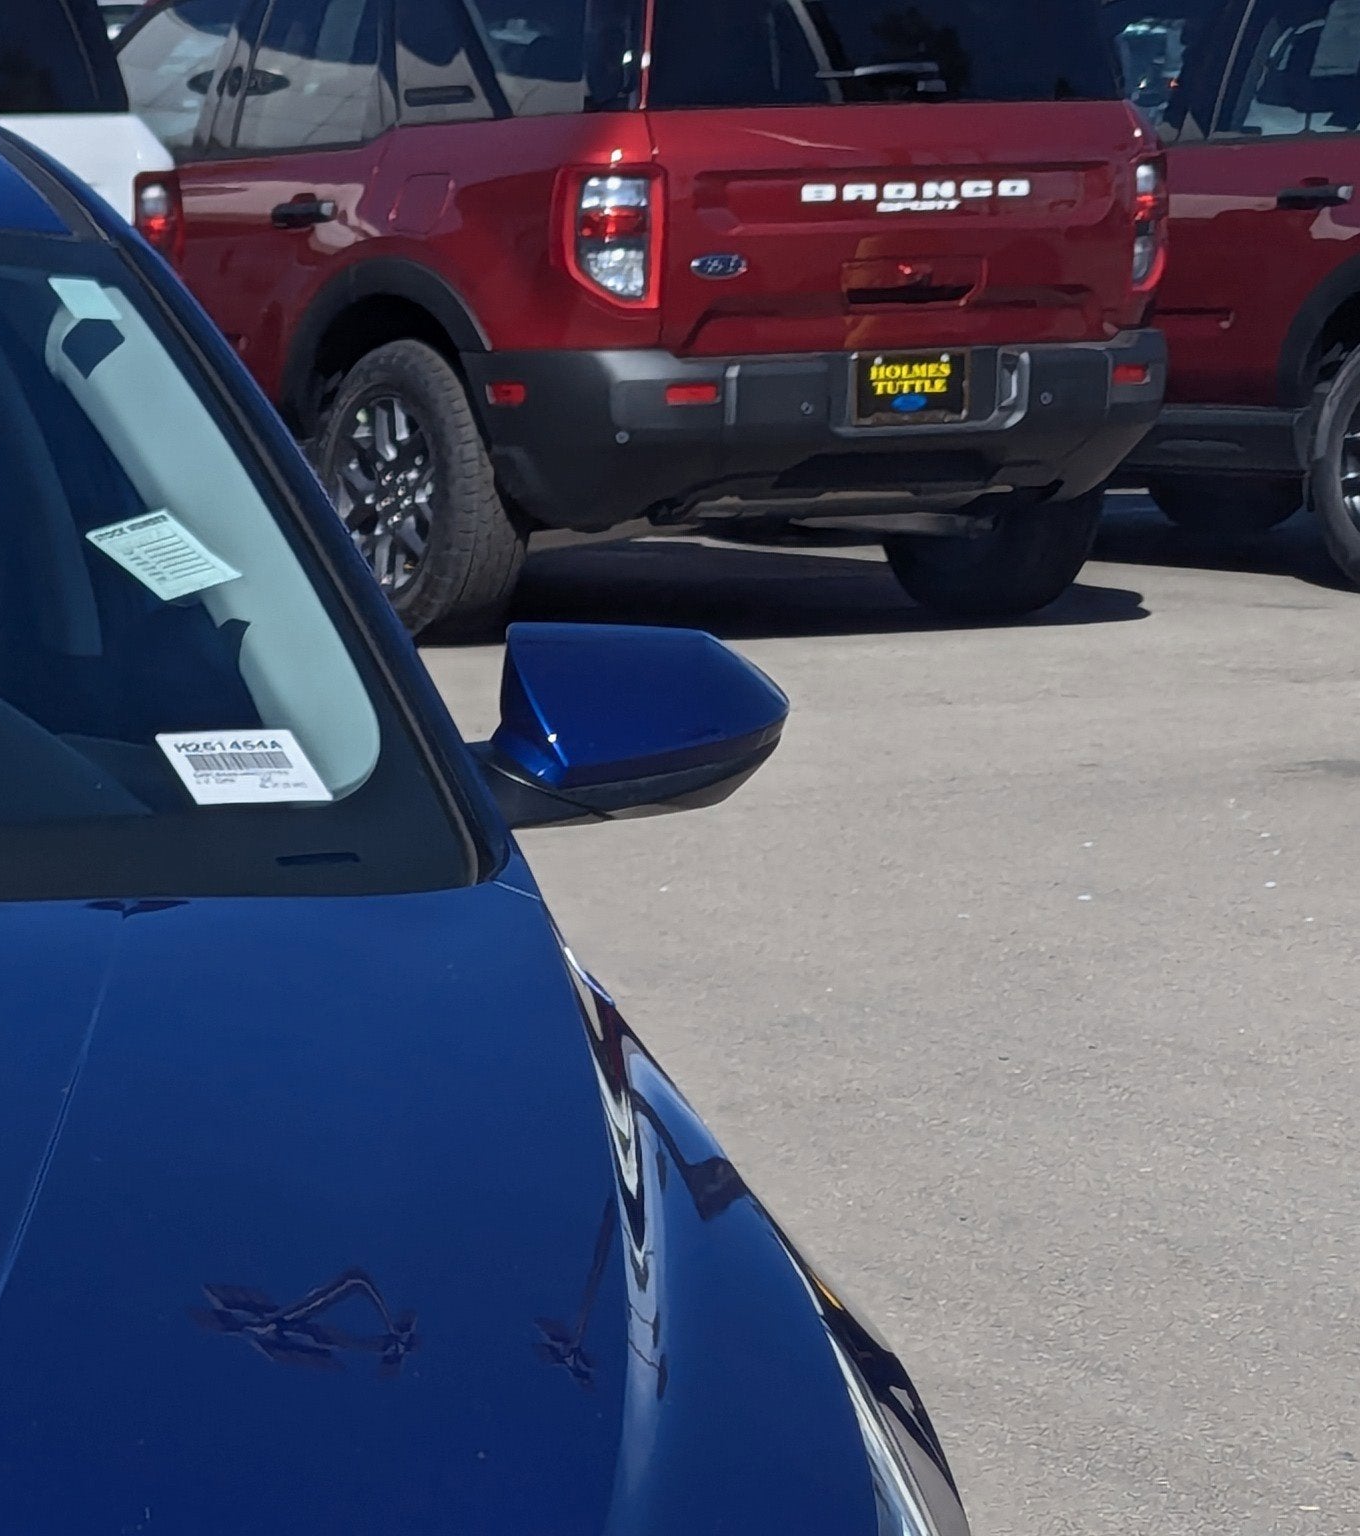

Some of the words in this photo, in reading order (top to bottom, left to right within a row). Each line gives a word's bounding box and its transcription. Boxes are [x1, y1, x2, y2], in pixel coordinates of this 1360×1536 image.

[800, 179, 1030, 202] BRONCO
[876, 199, 962, 212] SPORT
[869, 362, 951, 380] HOLMES
[871, 379, 947, 395] TUTTLE
